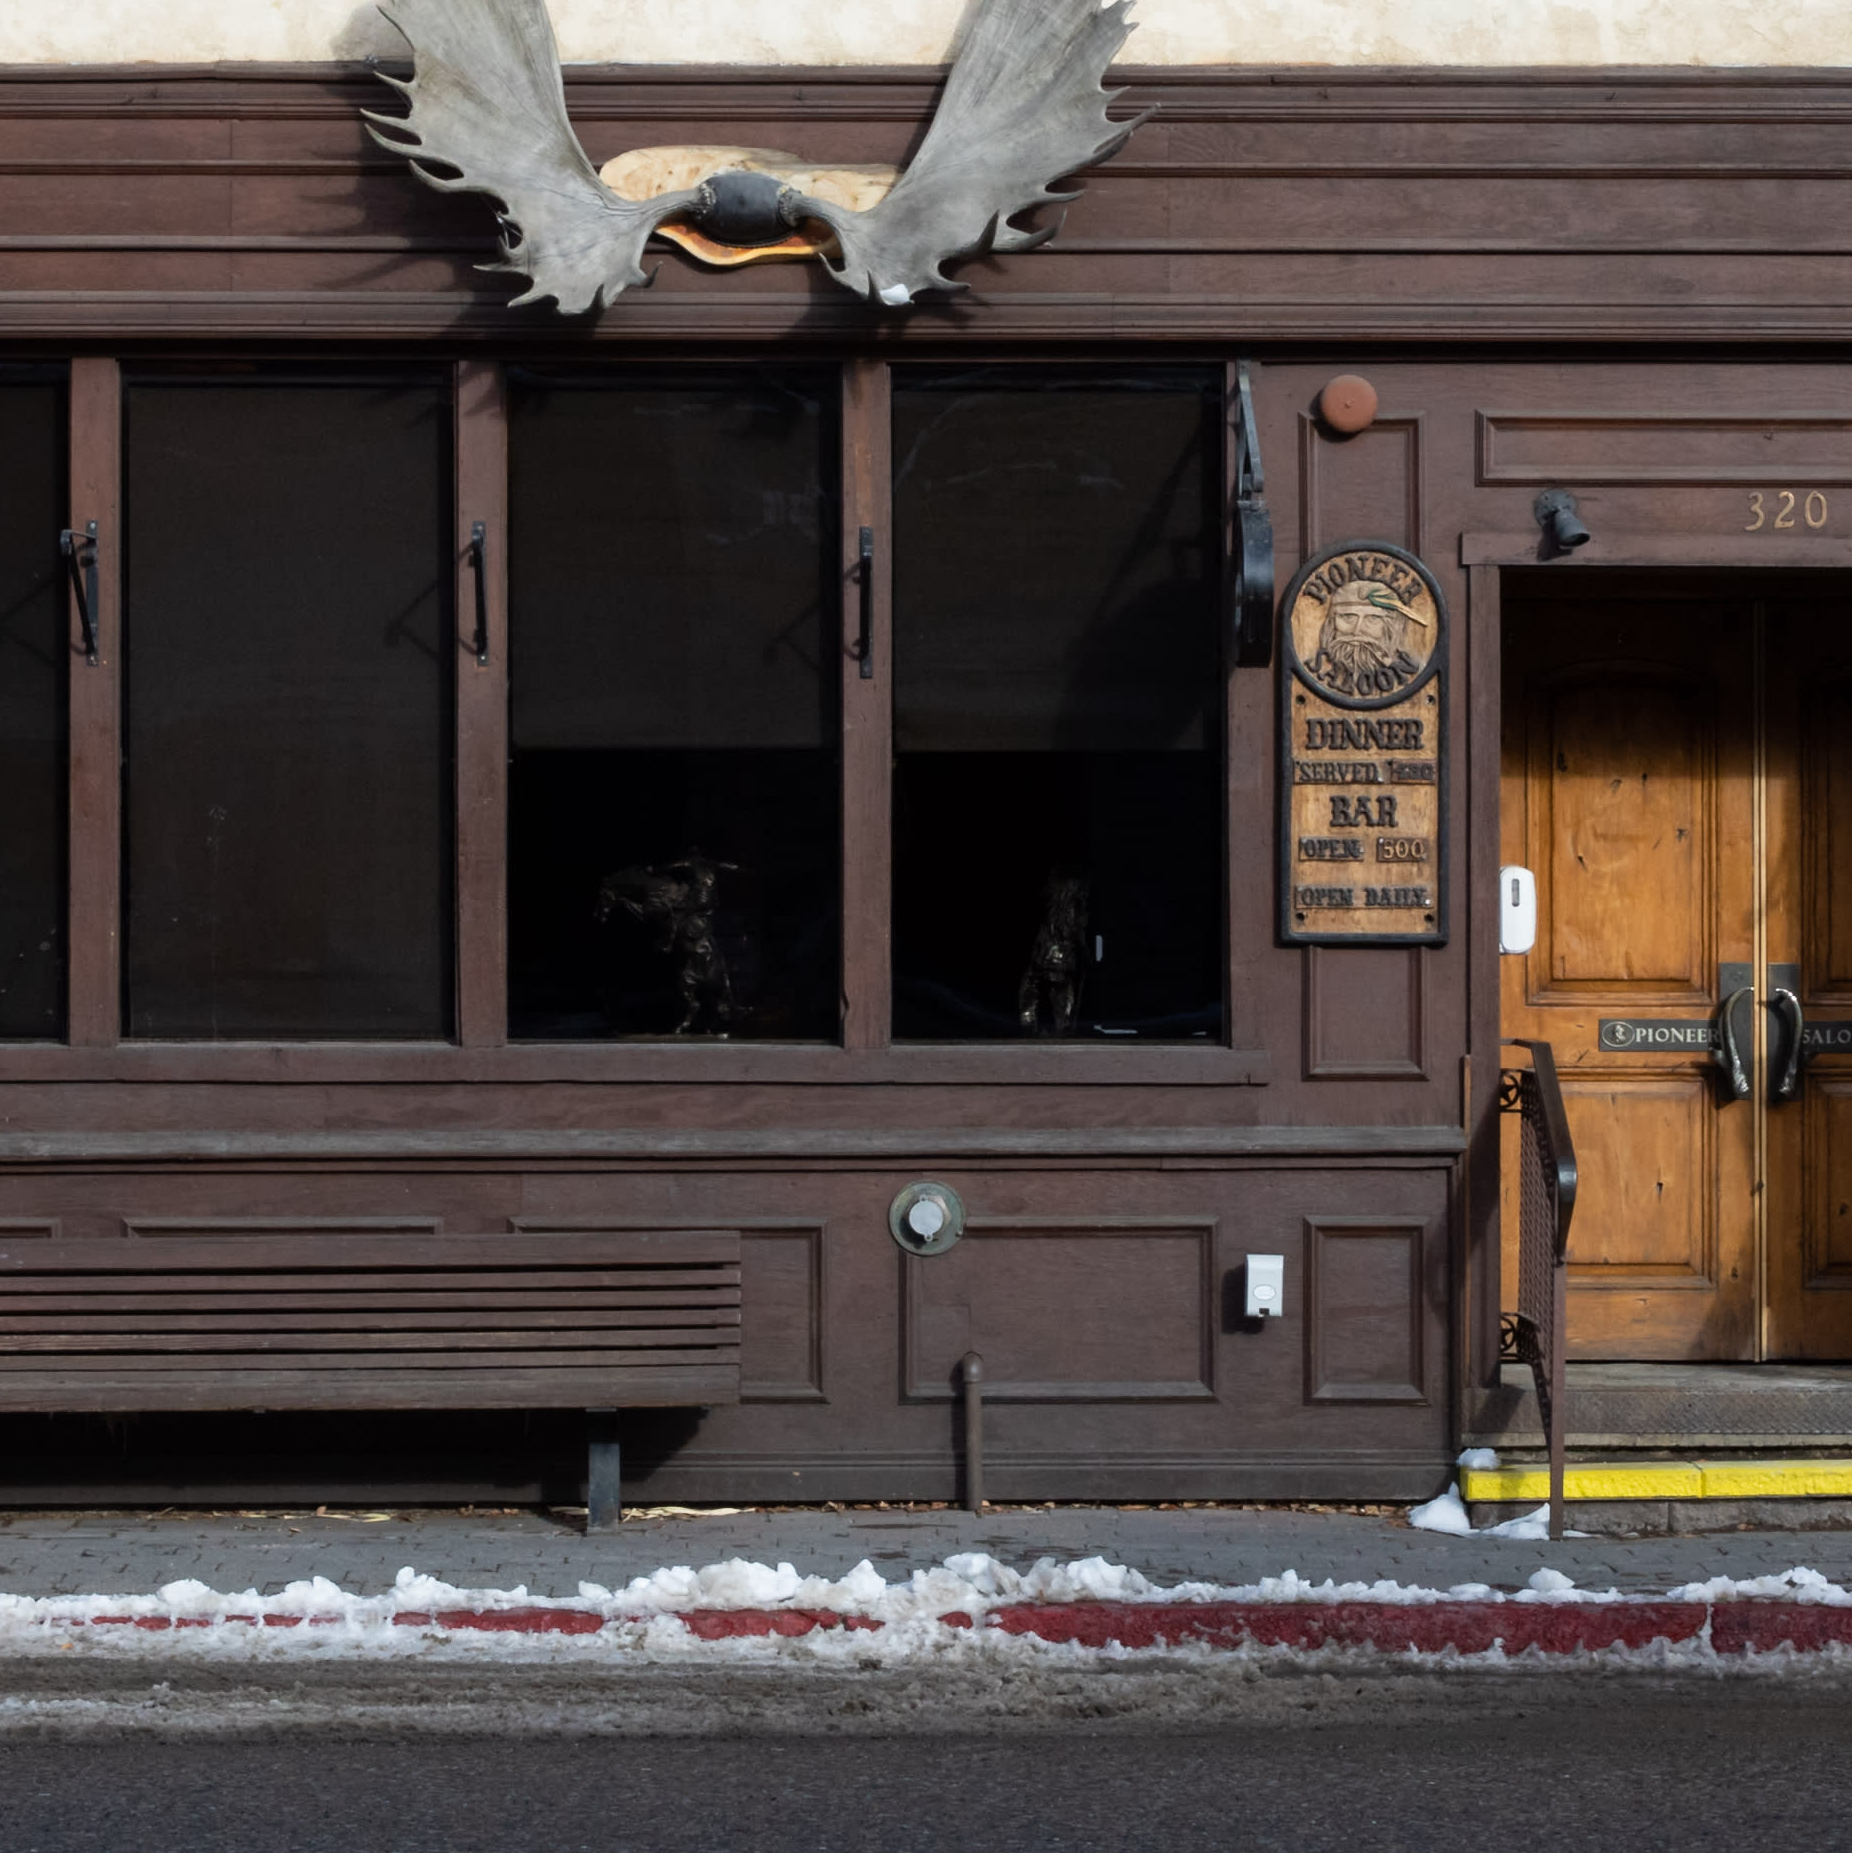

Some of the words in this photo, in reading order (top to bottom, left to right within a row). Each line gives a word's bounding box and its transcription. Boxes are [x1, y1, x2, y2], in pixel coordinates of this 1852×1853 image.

[1744, 490, 1828, 531] 320
[1303, 555, 1423, 605] PIONEER
[1304, 648, 1420, 696] SALOON
[1305, 718, 1425, 751] DINNER
[1298, 762, 1380, 783] SERVED
[1330, 795, 1399, 828] BAR
[1303, 839, 1361, 859] OPEN
[1300, 887, 1354, 907] OPEN
[1364, 887, 1428, 907] DAILY
[1634, 1027, 1721, 1044] PIONEER
